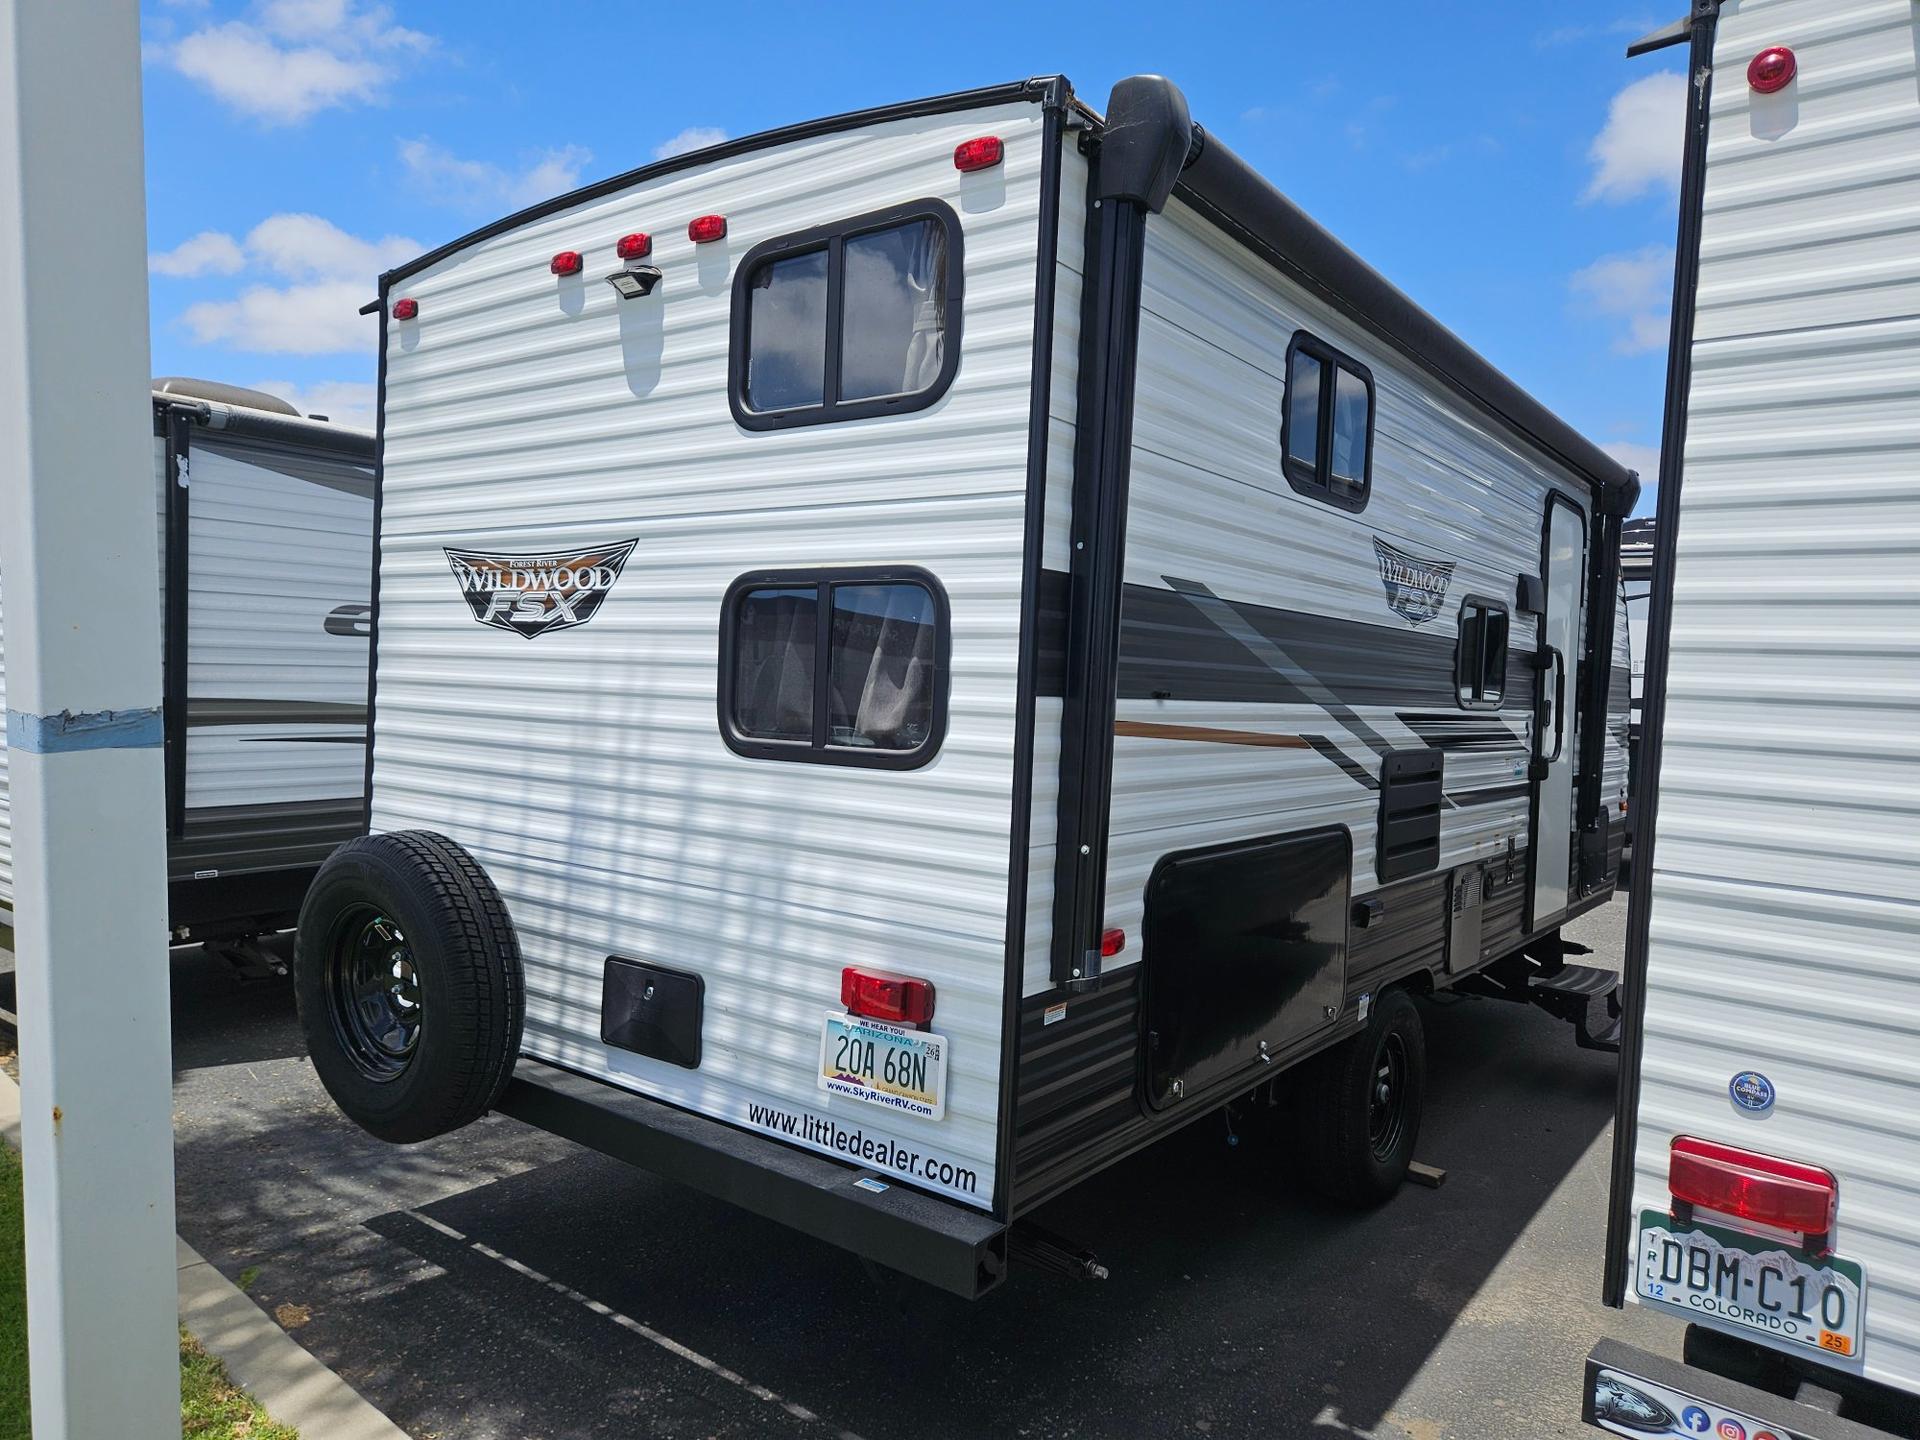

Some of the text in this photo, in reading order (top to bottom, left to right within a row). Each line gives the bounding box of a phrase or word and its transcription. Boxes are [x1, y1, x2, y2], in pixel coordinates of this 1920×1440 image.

[510, 560, 557, 568] FOREST RIVER
[1379, 557, 1448, 594] WILDWOOD
[456, 567, 617, 592] WILDWOOD
[483, 590, 592, 622] FSX
[855, 1027, 913, 1047] ARIZONA
[860, 1020, 905, 1036] WE HEAR YOU!
[884, 1047, 927, 1093] 68N
[827, 1081, 932, 1116] www.SkyRiverRV.com
[749, 1103, 977, 1194] www.littledealer.com
[1648, 1283, 1664, 1296] 12
[1689, 1294, 1798, 1335] COLORADO
[1825, 1333, 1843, 1348] 25
